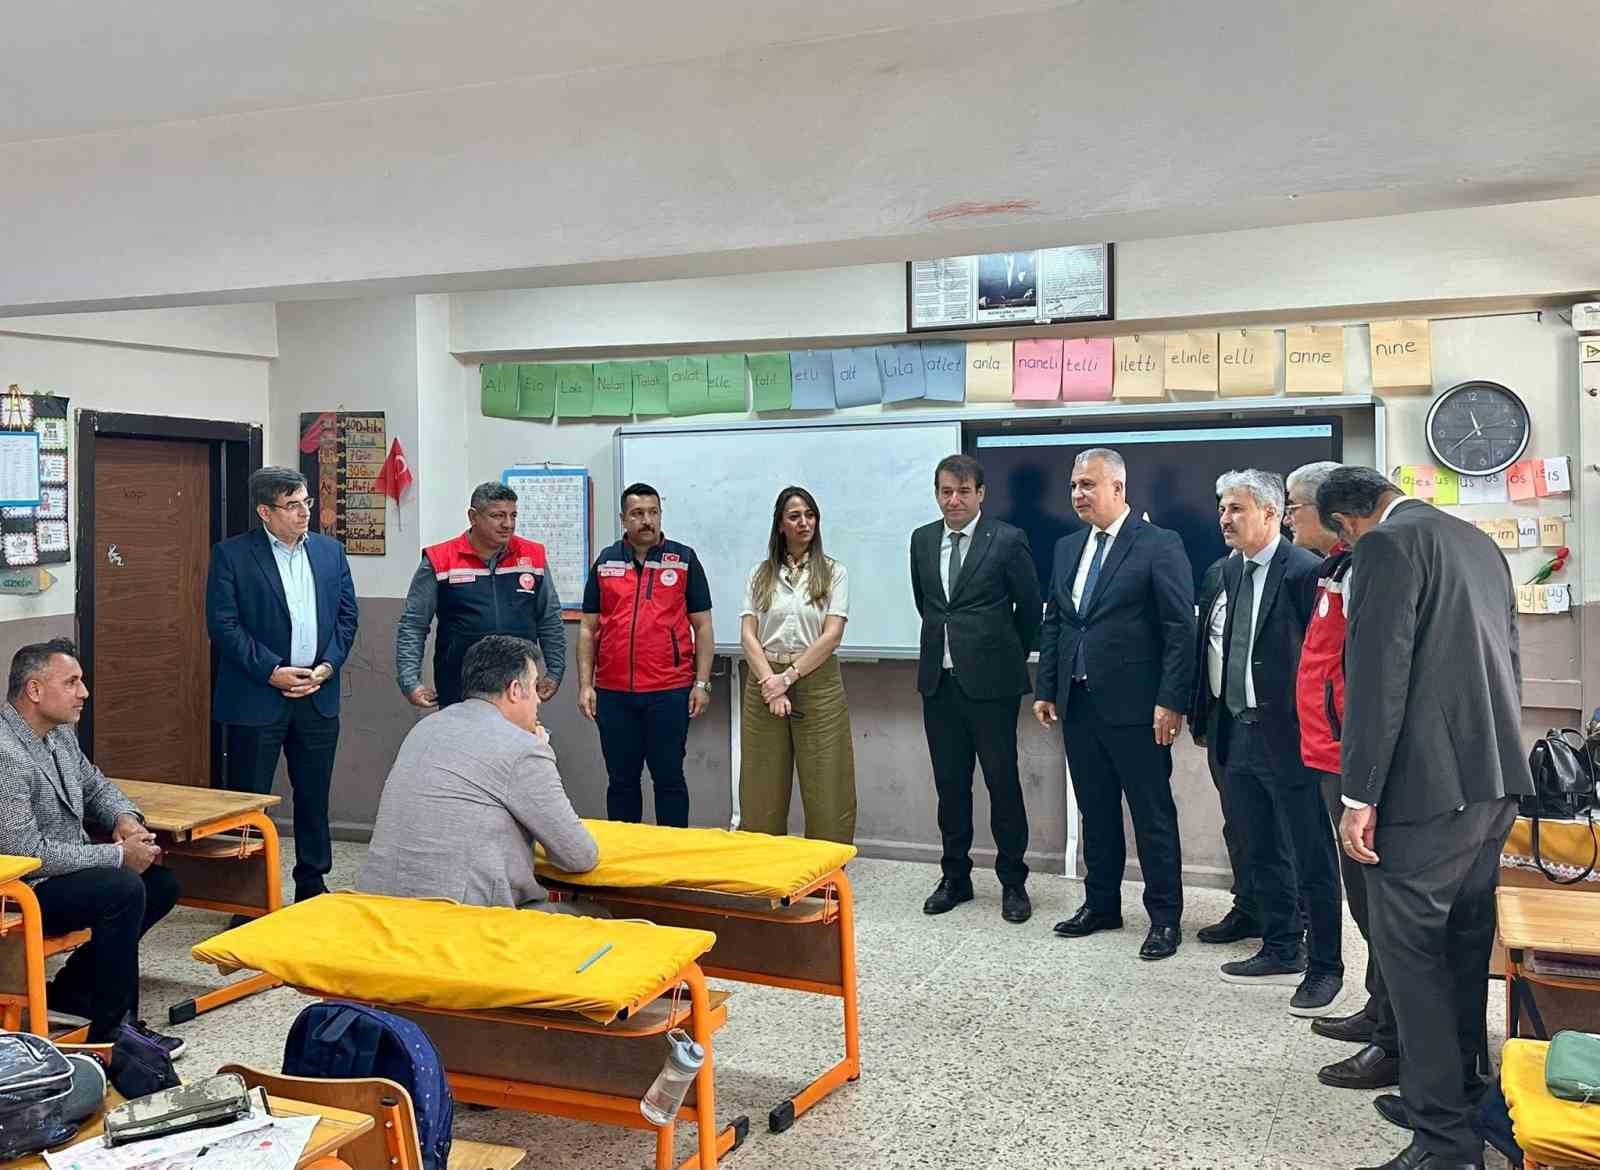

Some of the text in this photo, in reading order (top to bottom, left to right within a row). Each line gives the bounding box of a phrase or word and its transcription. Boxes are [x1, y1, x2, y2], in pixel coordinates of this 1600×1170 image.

[1376, 340, 1417, 357] nine
[1171, 348, 1210, 365] elinle
[1223, 347, 1255, 365] elli
[1288, 350, 1333, 364] anne
[884, 360, 913, 377] Lila
[927, 357, 961, 371] atlet
[972, 357, 1000, 370] anla
[1018, 357, 1058, 370] naneli
[1066, 358, 1098, 372] telli
